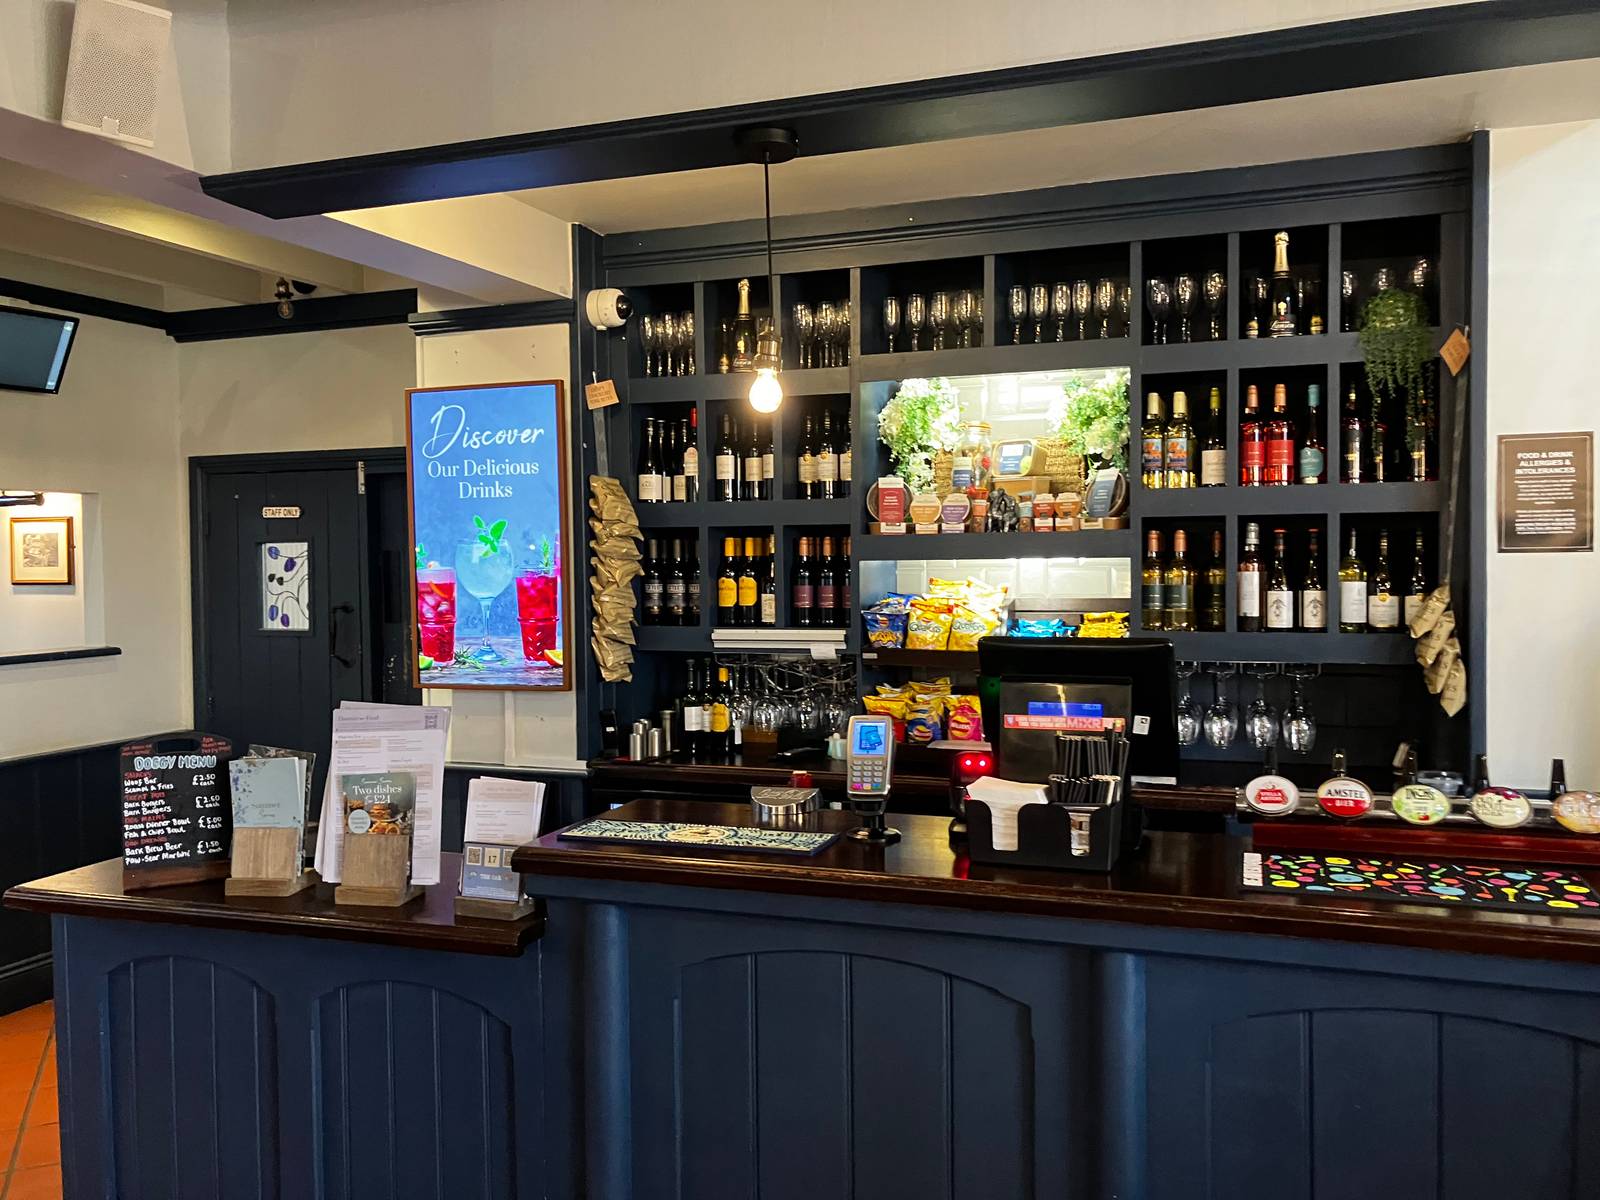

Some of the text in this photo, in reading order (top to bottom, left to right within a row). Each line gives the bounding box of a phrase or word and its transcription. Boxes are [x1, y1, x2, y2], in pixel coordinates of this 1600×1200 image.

[422, 404, 544, 458] Discover
[428, 458, 539, 478] Our Delicious
[458, 481, 512, 499] Drinks
[264, 508, 298, 516] STAFF ONLY
[134, 755, 216, 772] DOGGY MENU
[352, 784, 402, 796] Two dishes
[1327, 789, 1364, 798] AMSTEL
[488, 856, 497, 864] 17
